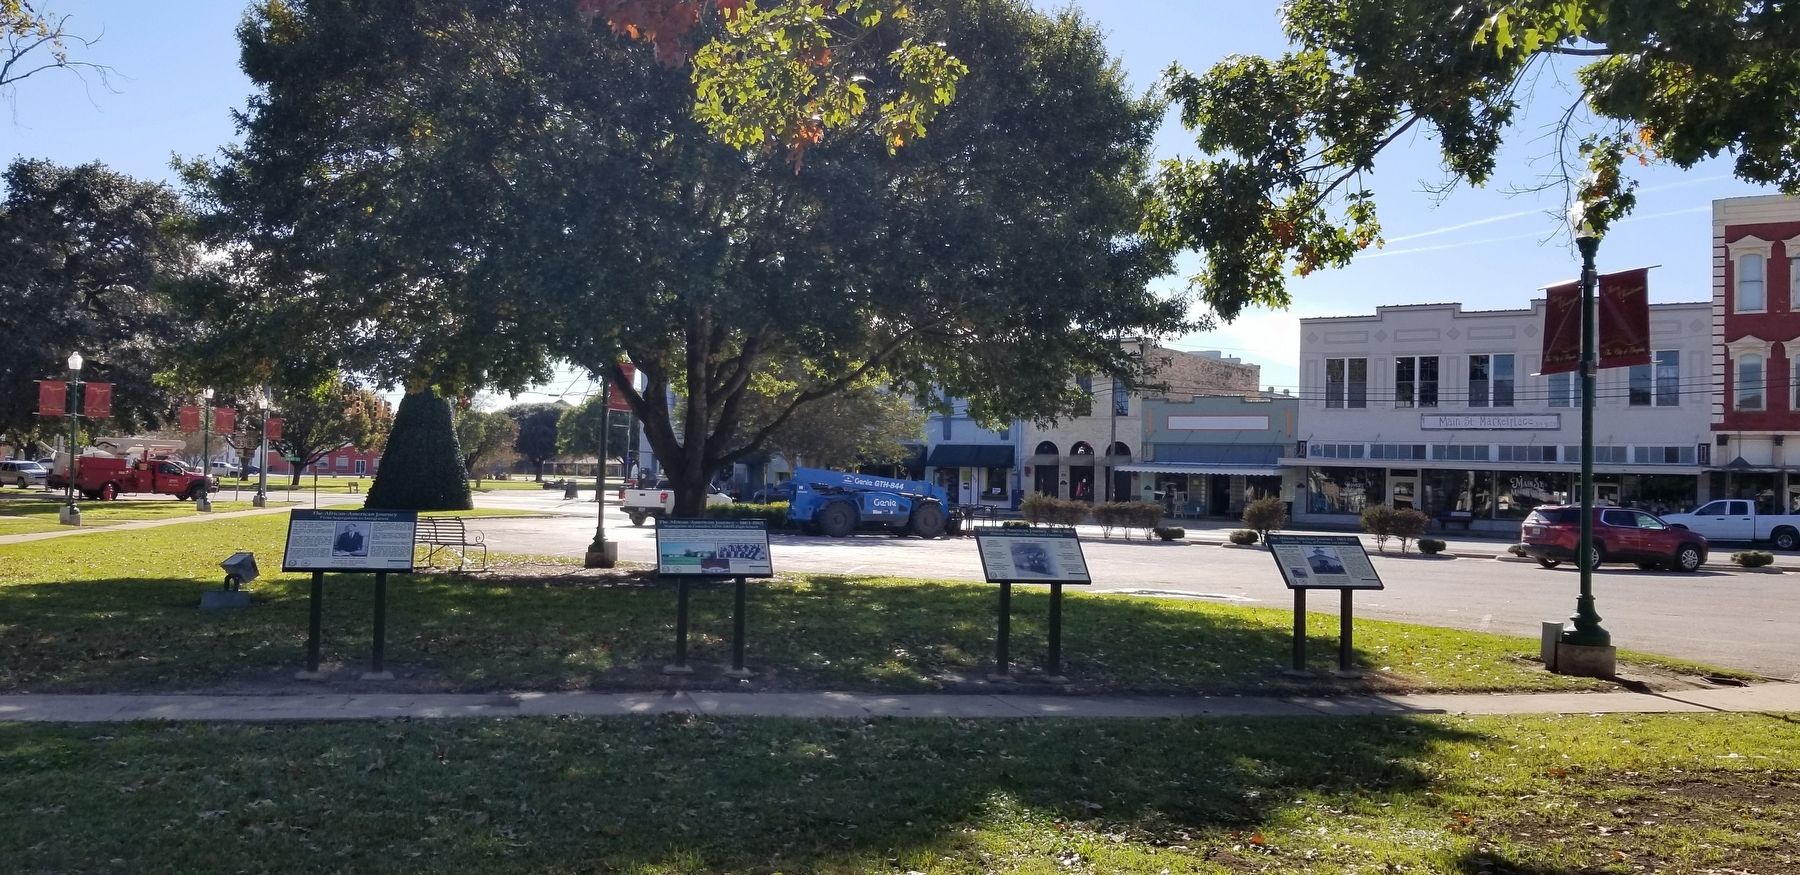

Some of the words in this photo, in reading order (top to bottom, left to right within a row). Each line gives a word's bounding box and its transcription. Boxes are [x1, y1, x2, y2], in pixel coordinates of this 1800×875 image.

[1439, 416, 1461, 427] Main
[854, 477, 873, 486] Genie
[874, 480, 904, 490] GTH-844
[873, 498, 897, 507] Genie
